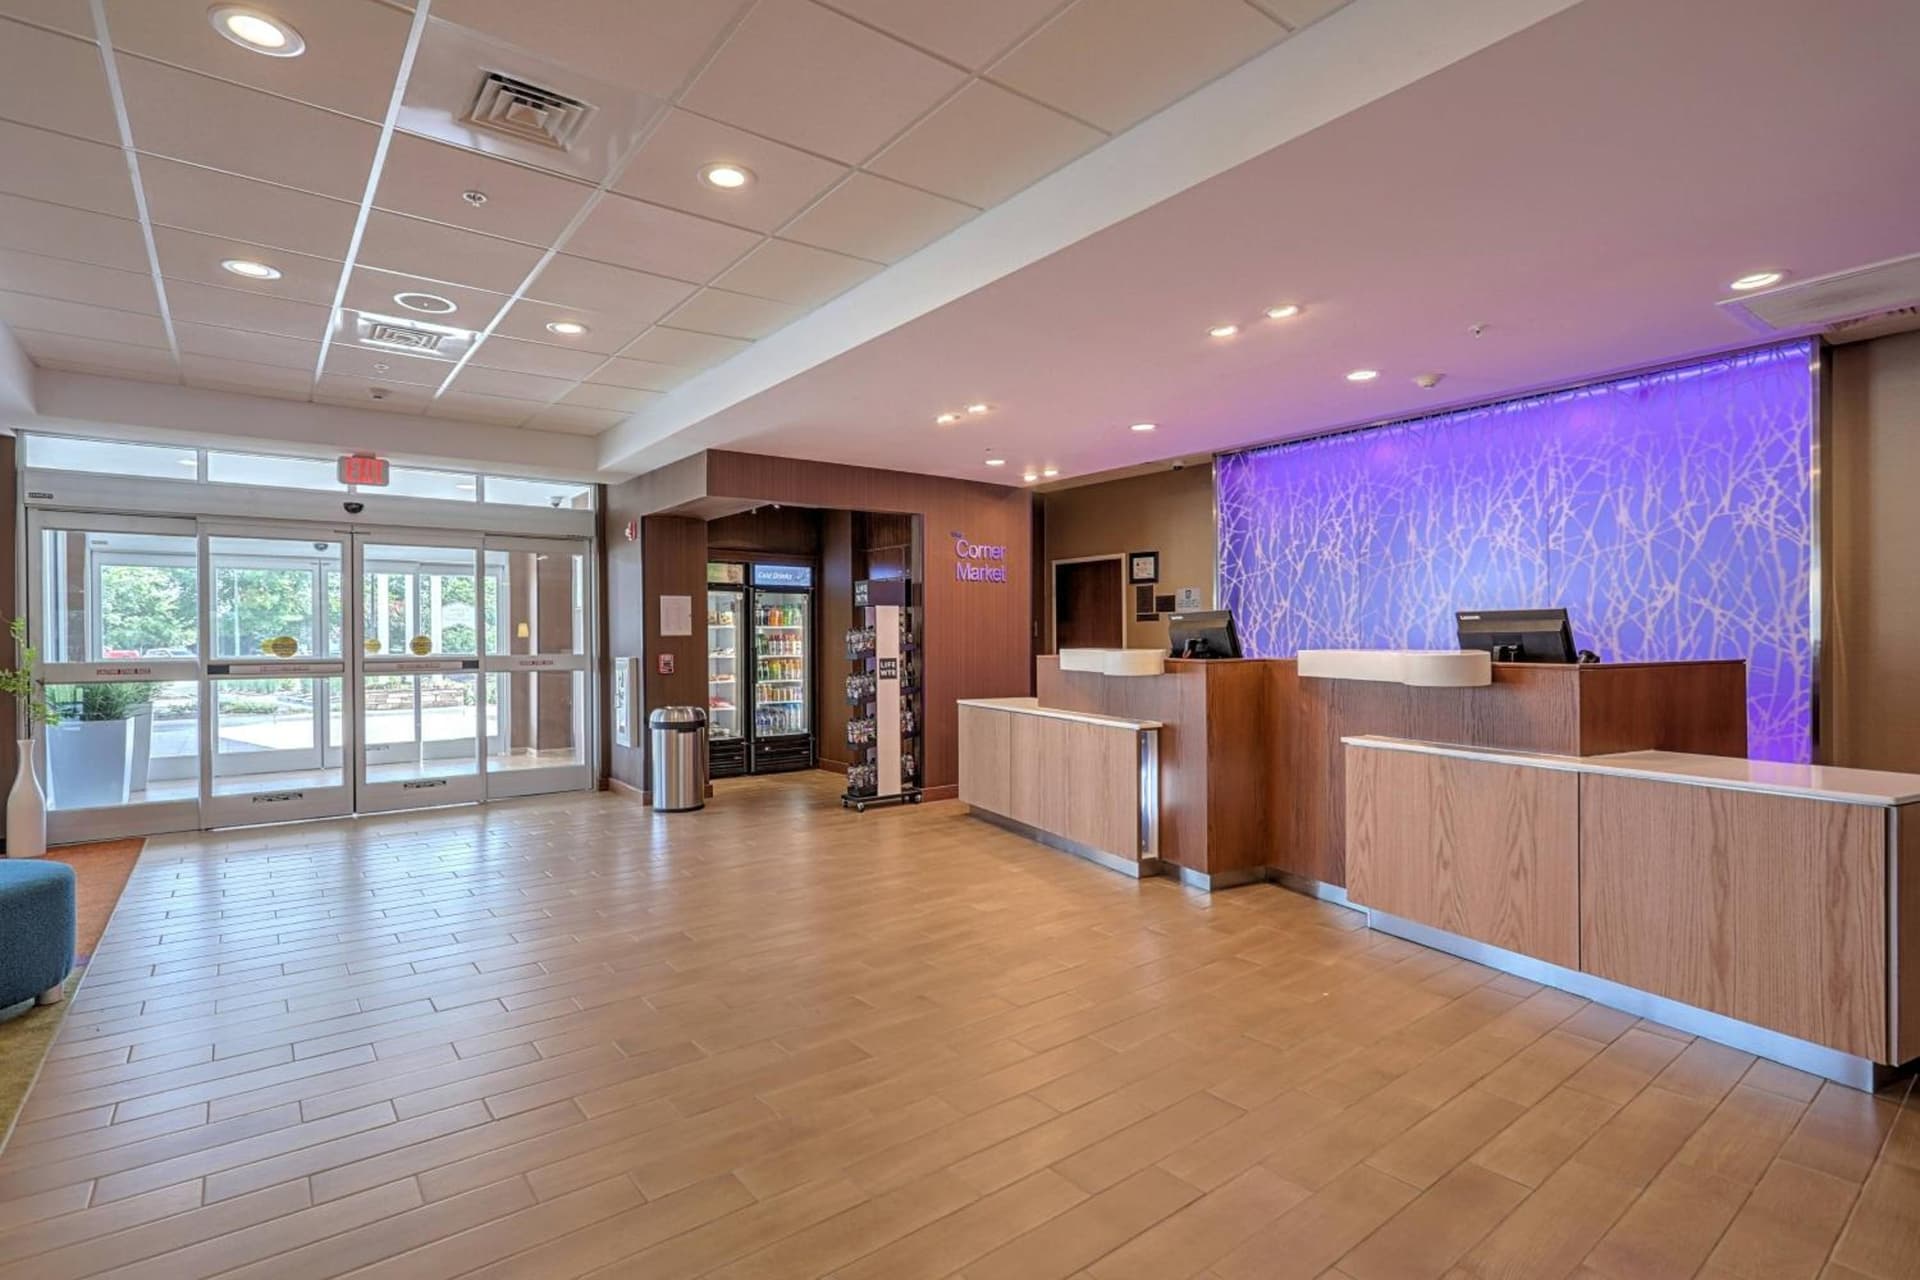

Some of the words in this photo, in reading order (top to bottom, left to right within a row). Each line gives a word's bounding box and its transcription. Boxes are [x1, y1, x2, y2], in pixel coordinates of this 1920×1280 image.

[346, 458, 384, 485] EXIT
[956, 539, 1006, 560] Corner
[956, 562, 1007, 583] Market
[880, 661, 896, 669] LIFE
